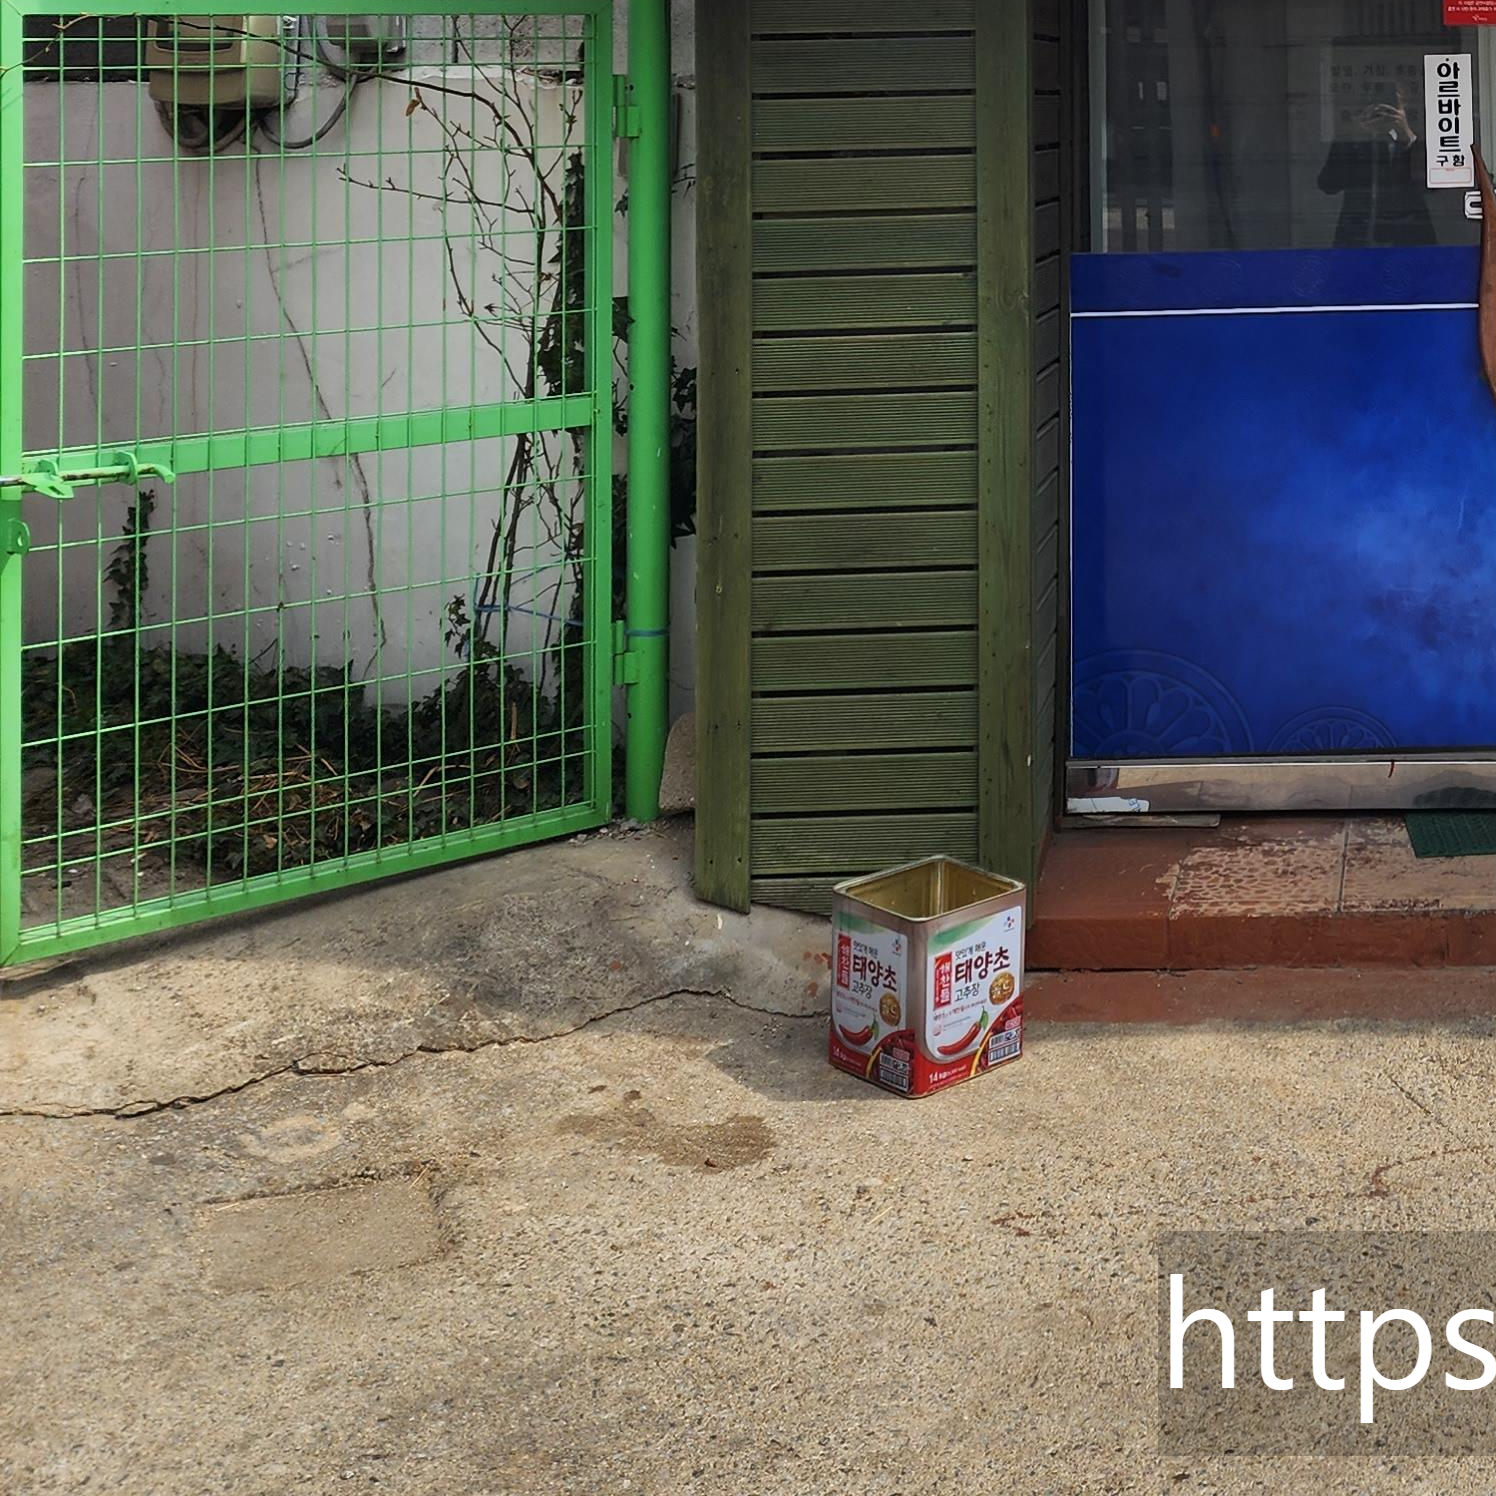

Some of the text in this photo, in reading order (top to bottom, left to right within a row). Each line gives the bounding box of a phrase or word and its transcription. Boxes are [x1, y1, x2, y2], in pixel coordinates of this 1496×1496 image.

[1437, 61, 1461, 152] 아르바이트
[852, 954, 897, 992] 태양초
[954, 946, 1011, 984] 태양초
[954, 983, 980, 1002] 고추장
